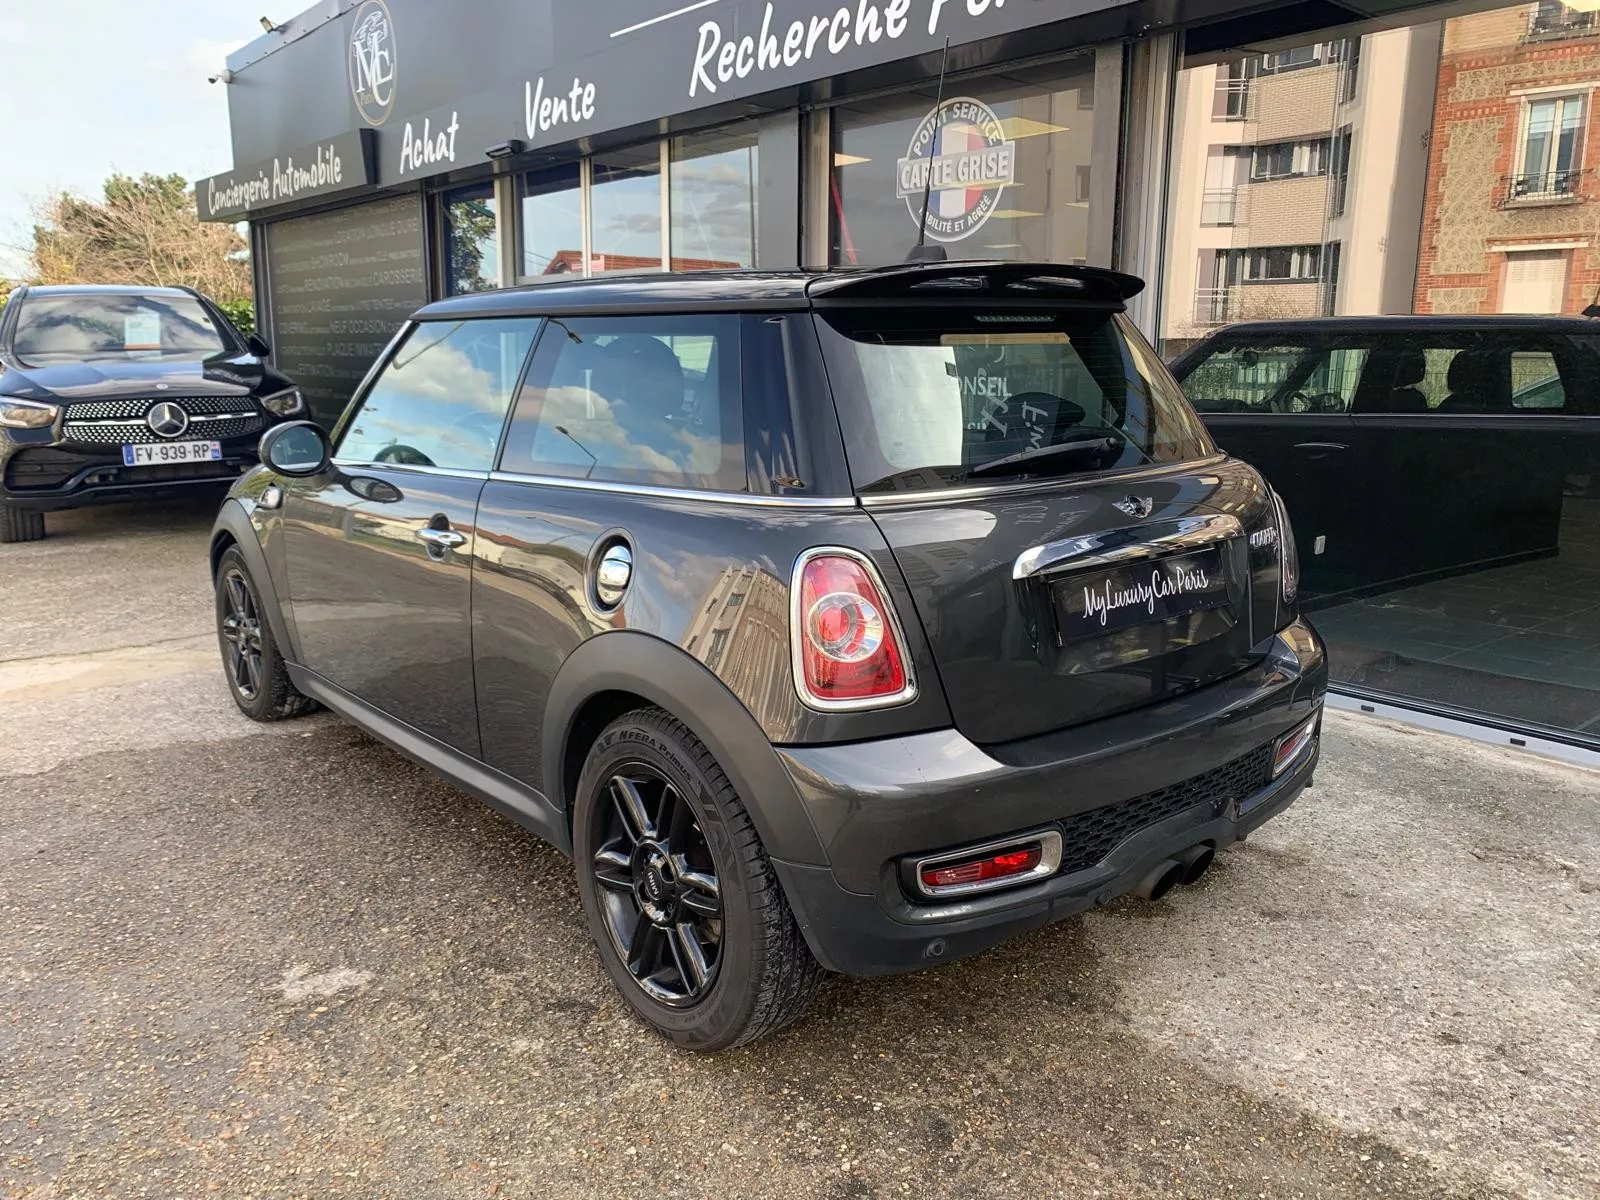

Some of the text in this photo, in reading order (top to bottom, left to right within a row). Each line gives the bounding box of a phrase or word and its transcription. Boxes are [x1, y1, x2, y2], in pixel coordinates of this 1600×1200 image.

[689, 0, 908, 97] Recherche
[525, 77, 596, 140] Vente
[914, 103, 1001, 156] POINT SERVICE
[400, 111, 459, 175] Achat
[901, 150, 1010, 189] CARTE GRISE
[208, 144, 342, 216] Conciergerie Automobile
[954, 219, 965, 232] ET
[135, 444, 209, 462] FV-939-RP
[647, 871, 659, 895] MINI
